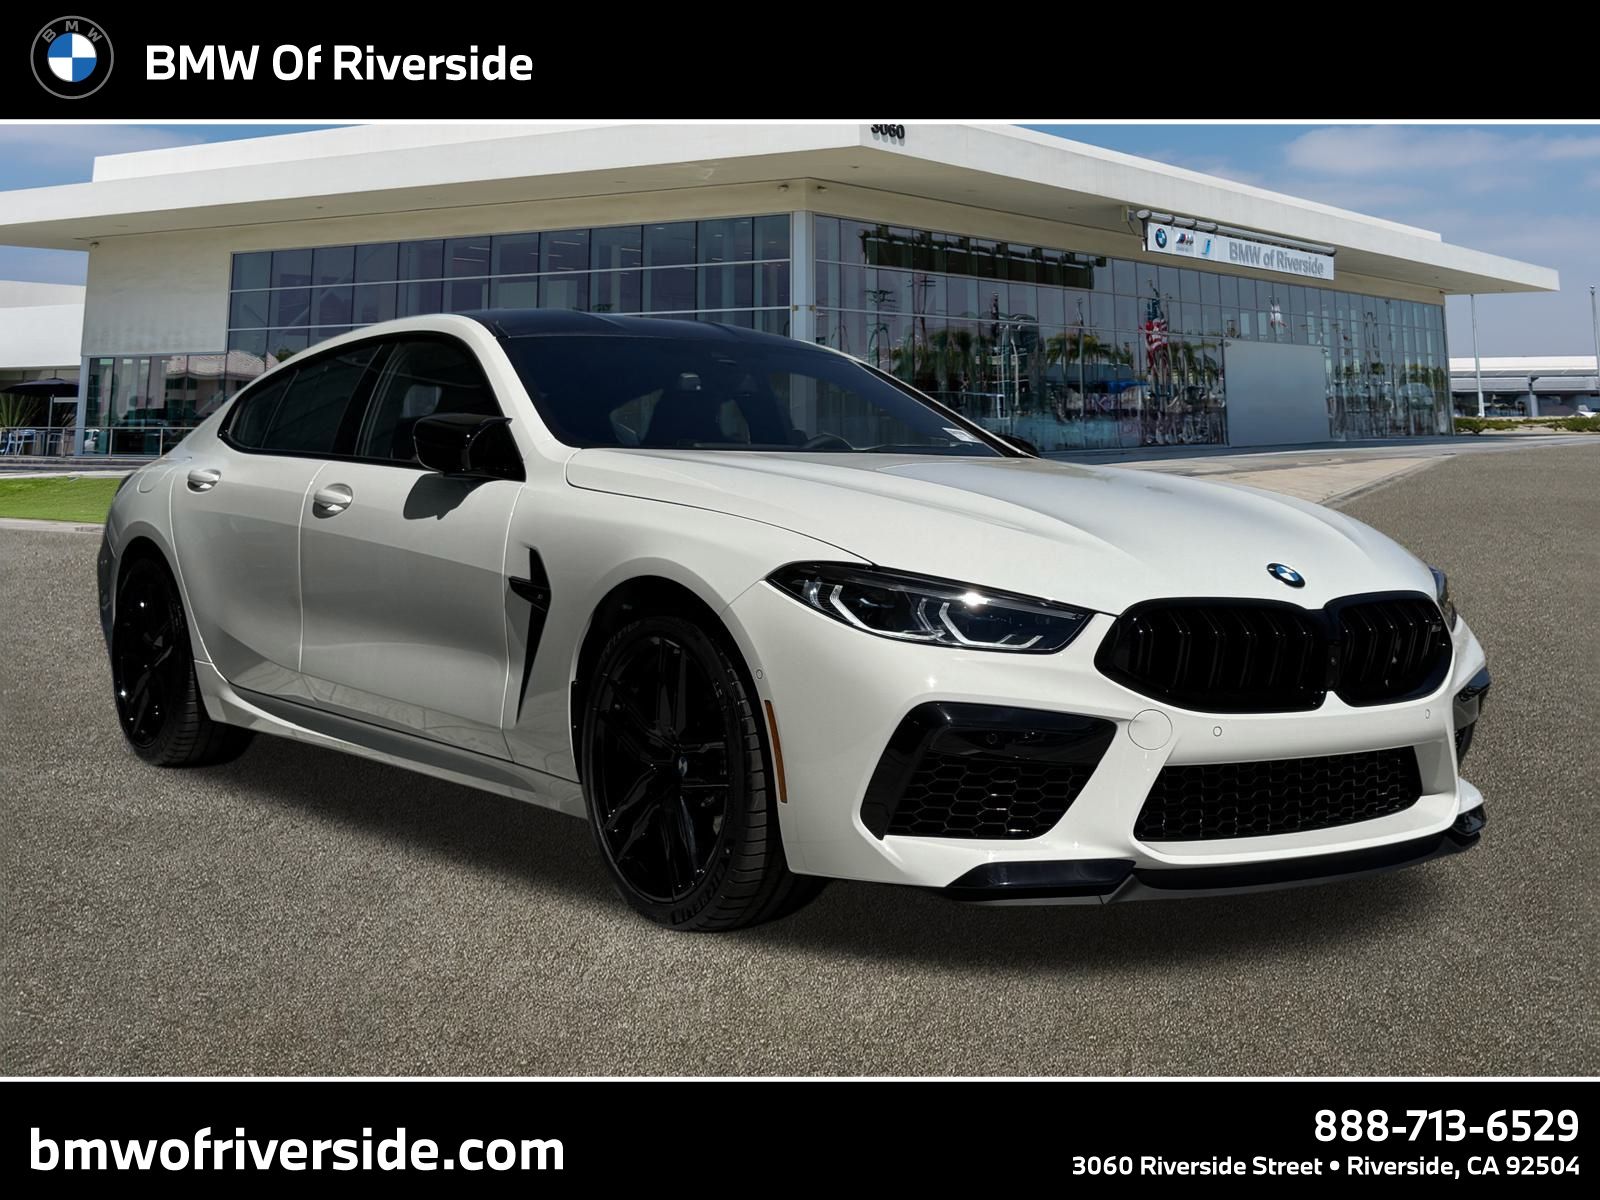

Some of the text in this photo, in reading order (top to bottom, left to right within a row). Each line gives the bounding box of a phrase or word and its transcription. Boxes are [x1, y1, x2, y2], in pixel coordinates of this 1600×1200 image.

[1229, 241, 1261, 264] BMW
[1263, 249, 1275, 267] of
[1276, 250, 1324, 275] Riverside
